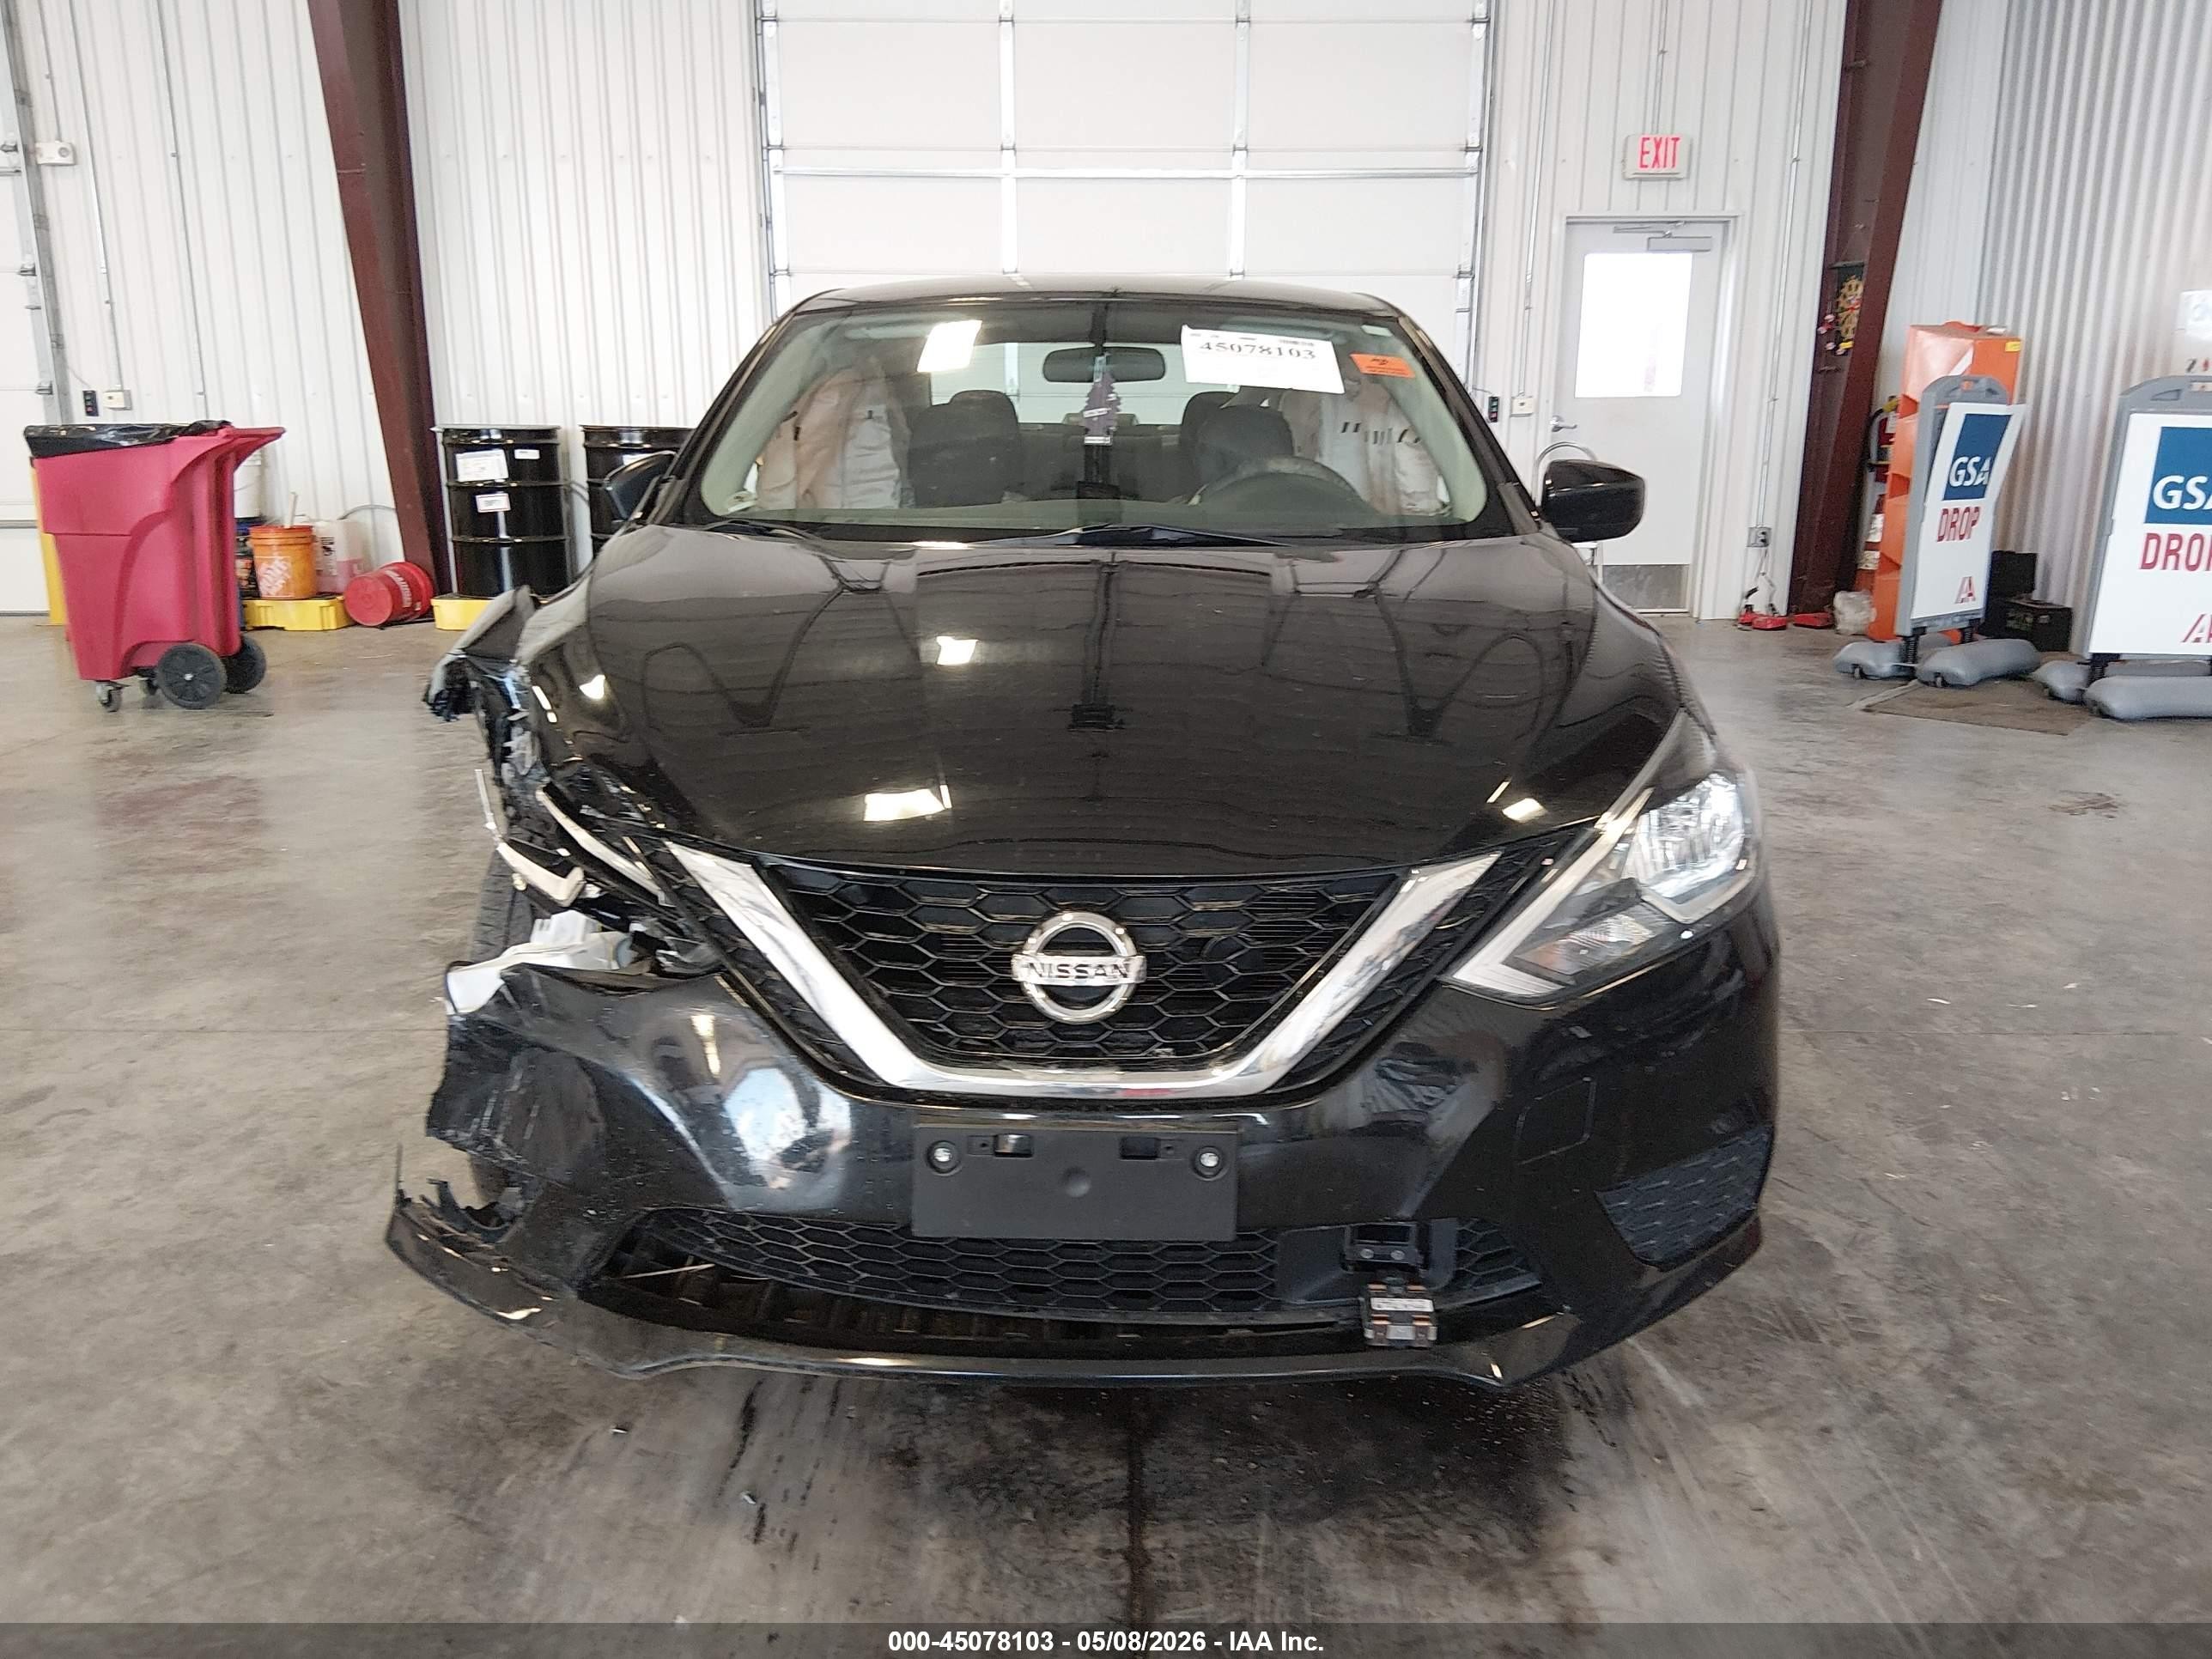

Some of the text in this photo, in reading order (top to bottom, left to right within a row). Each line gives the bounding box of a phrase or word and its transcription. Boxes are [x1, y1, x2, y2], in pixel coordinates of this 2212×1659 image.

[1639, 137, 1680, 168] EXIT
[1200, 342, 1316, 359] 45078103
[1949, 456, 1990, 487] GSA
[1937, 507, 1980, 542] DROP
[1023, 962, 1131, 979] NISSAN
